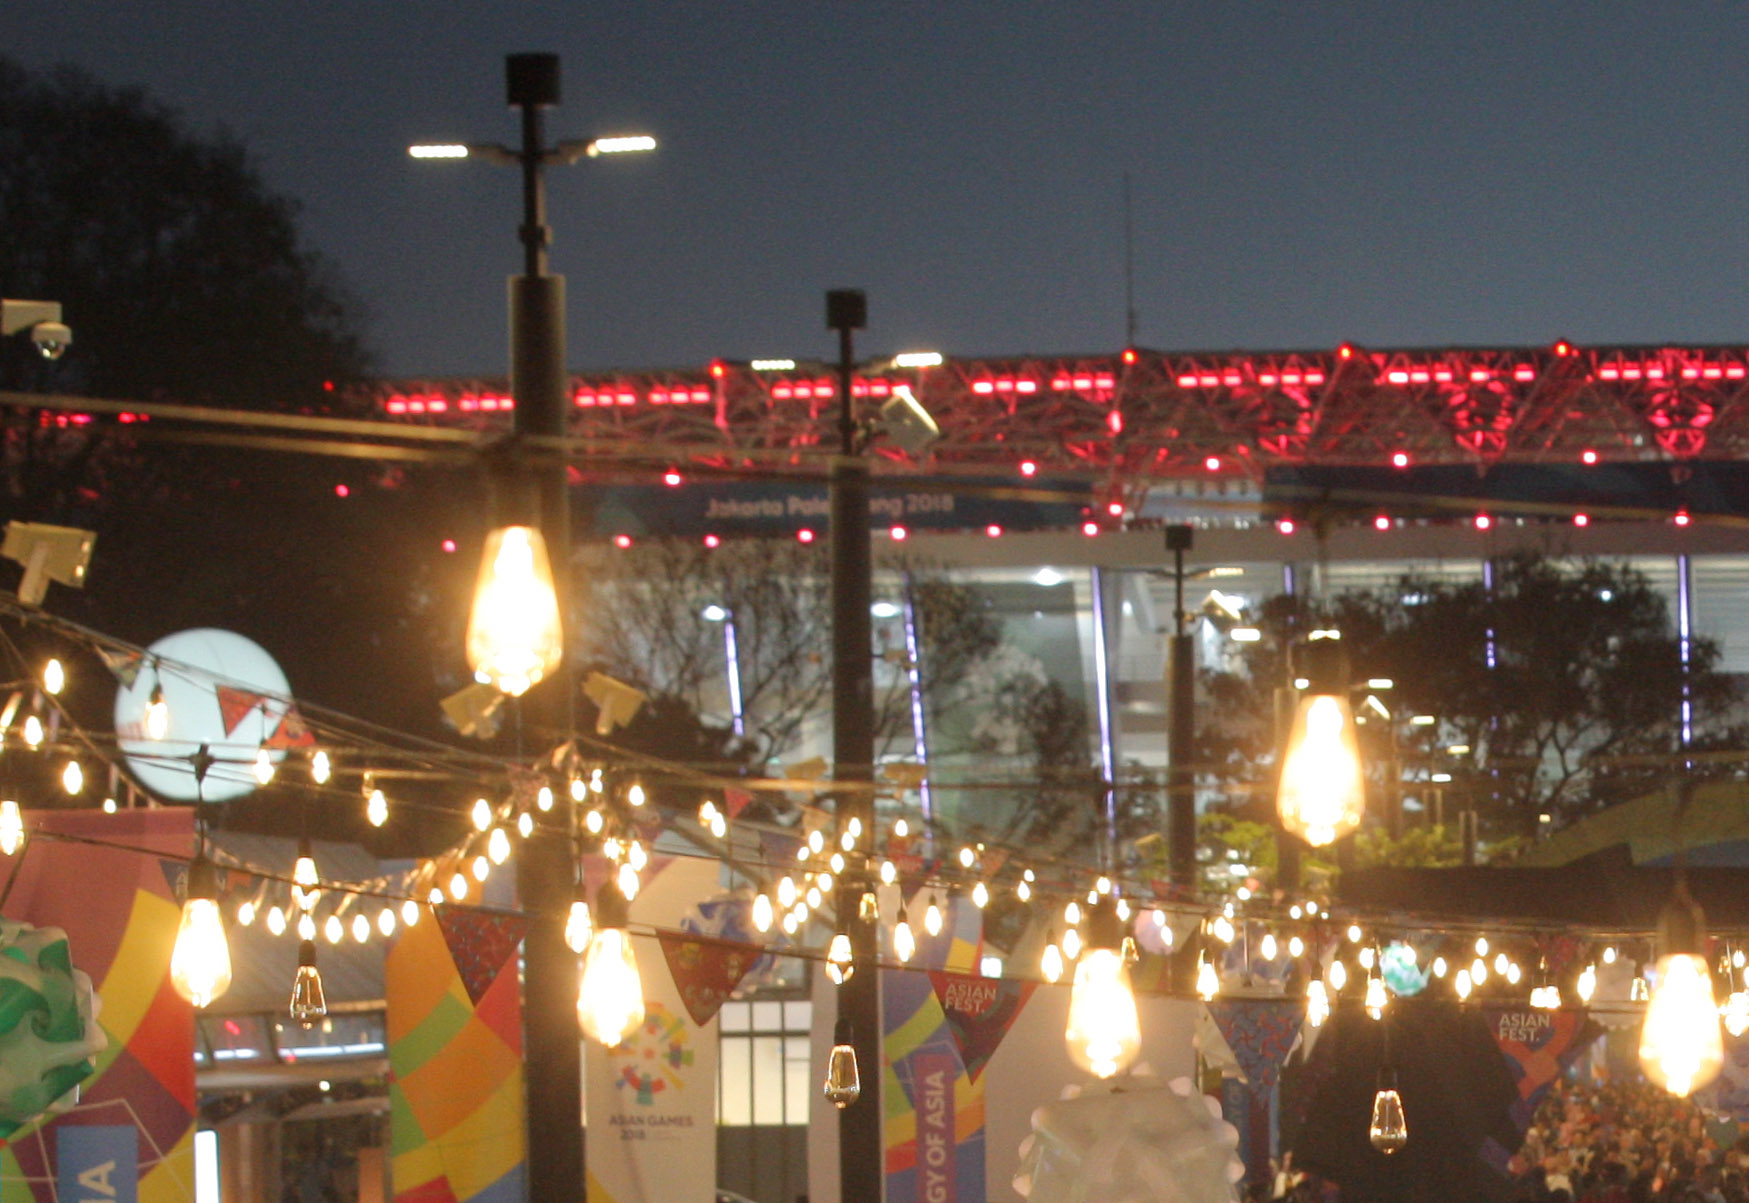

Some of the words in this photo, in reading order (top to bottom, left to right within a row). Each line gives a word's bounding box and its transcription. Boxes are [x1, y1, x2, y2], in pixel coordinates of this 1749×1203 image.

[945, 983, 996, 1000] ASIAN
[944, 997, 986, 1013] FEST.
[1500, 1013, 1550, 1028] ASIAN
[1499, 1026, 1540, 1042] FEST.
[926, 1071, 945, 1129] ASIA
[927, 1134, 946, 1166] OF
